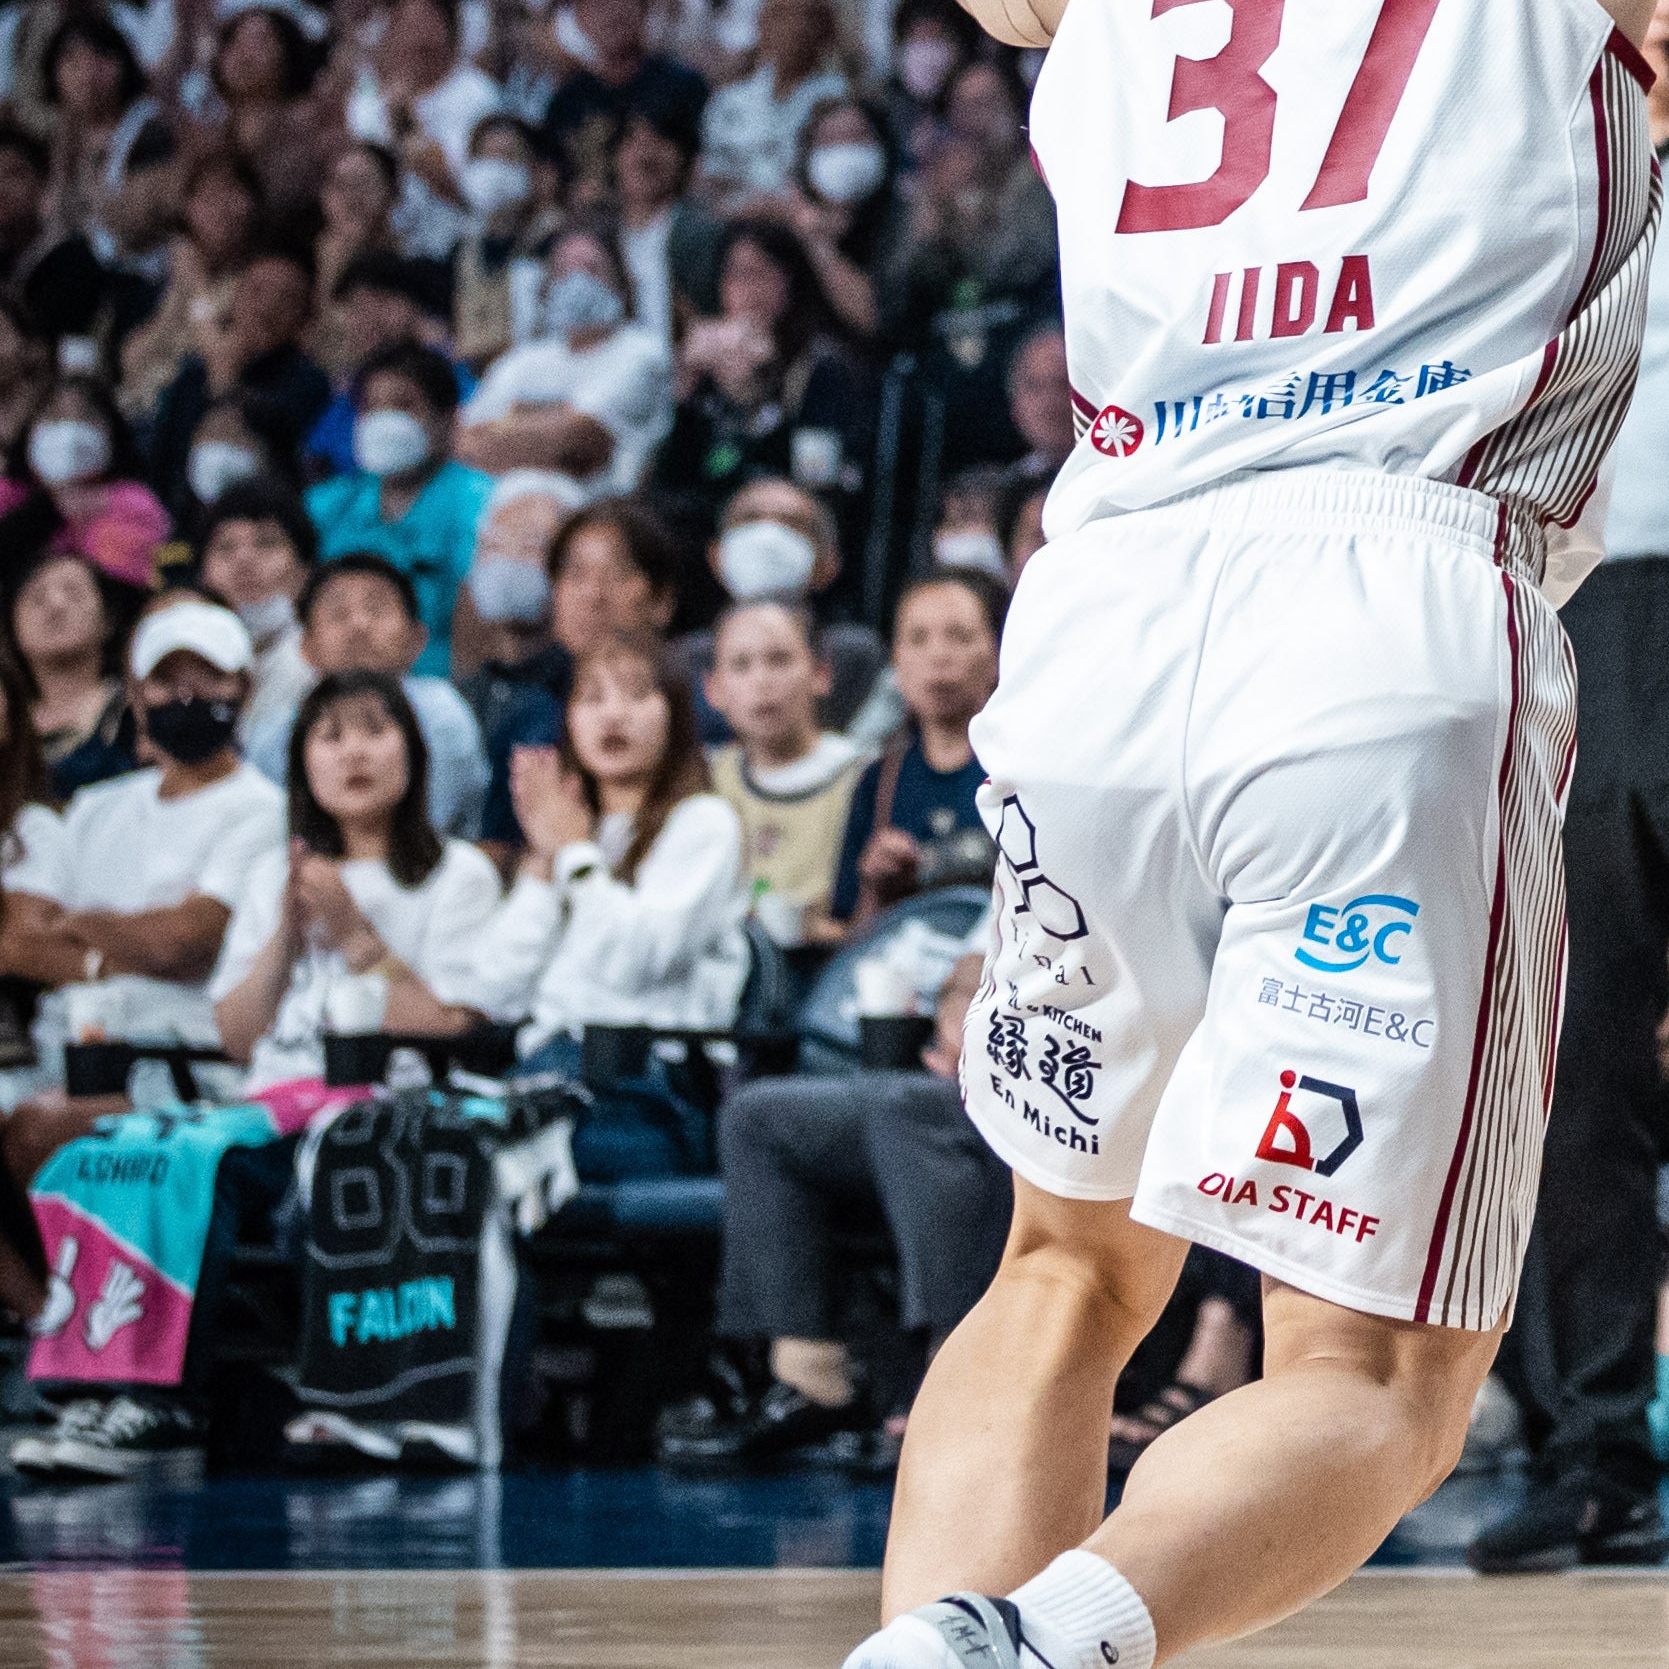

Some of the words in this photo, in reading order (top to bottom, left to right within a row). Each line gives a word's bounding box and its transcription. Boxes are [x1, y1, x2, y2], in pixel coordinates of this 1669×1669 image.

[1202, 255, 1376, 345] IIDA
[1302, 902, 1413, 965] E&C
[1257, 976, 1435, 1048] 富士古河E&C
[989, 1072, 1016, 1110] En
[1022, 1098, 1100, 1155] Michi
[1267, 1184, 1381, 1243] STAFF
